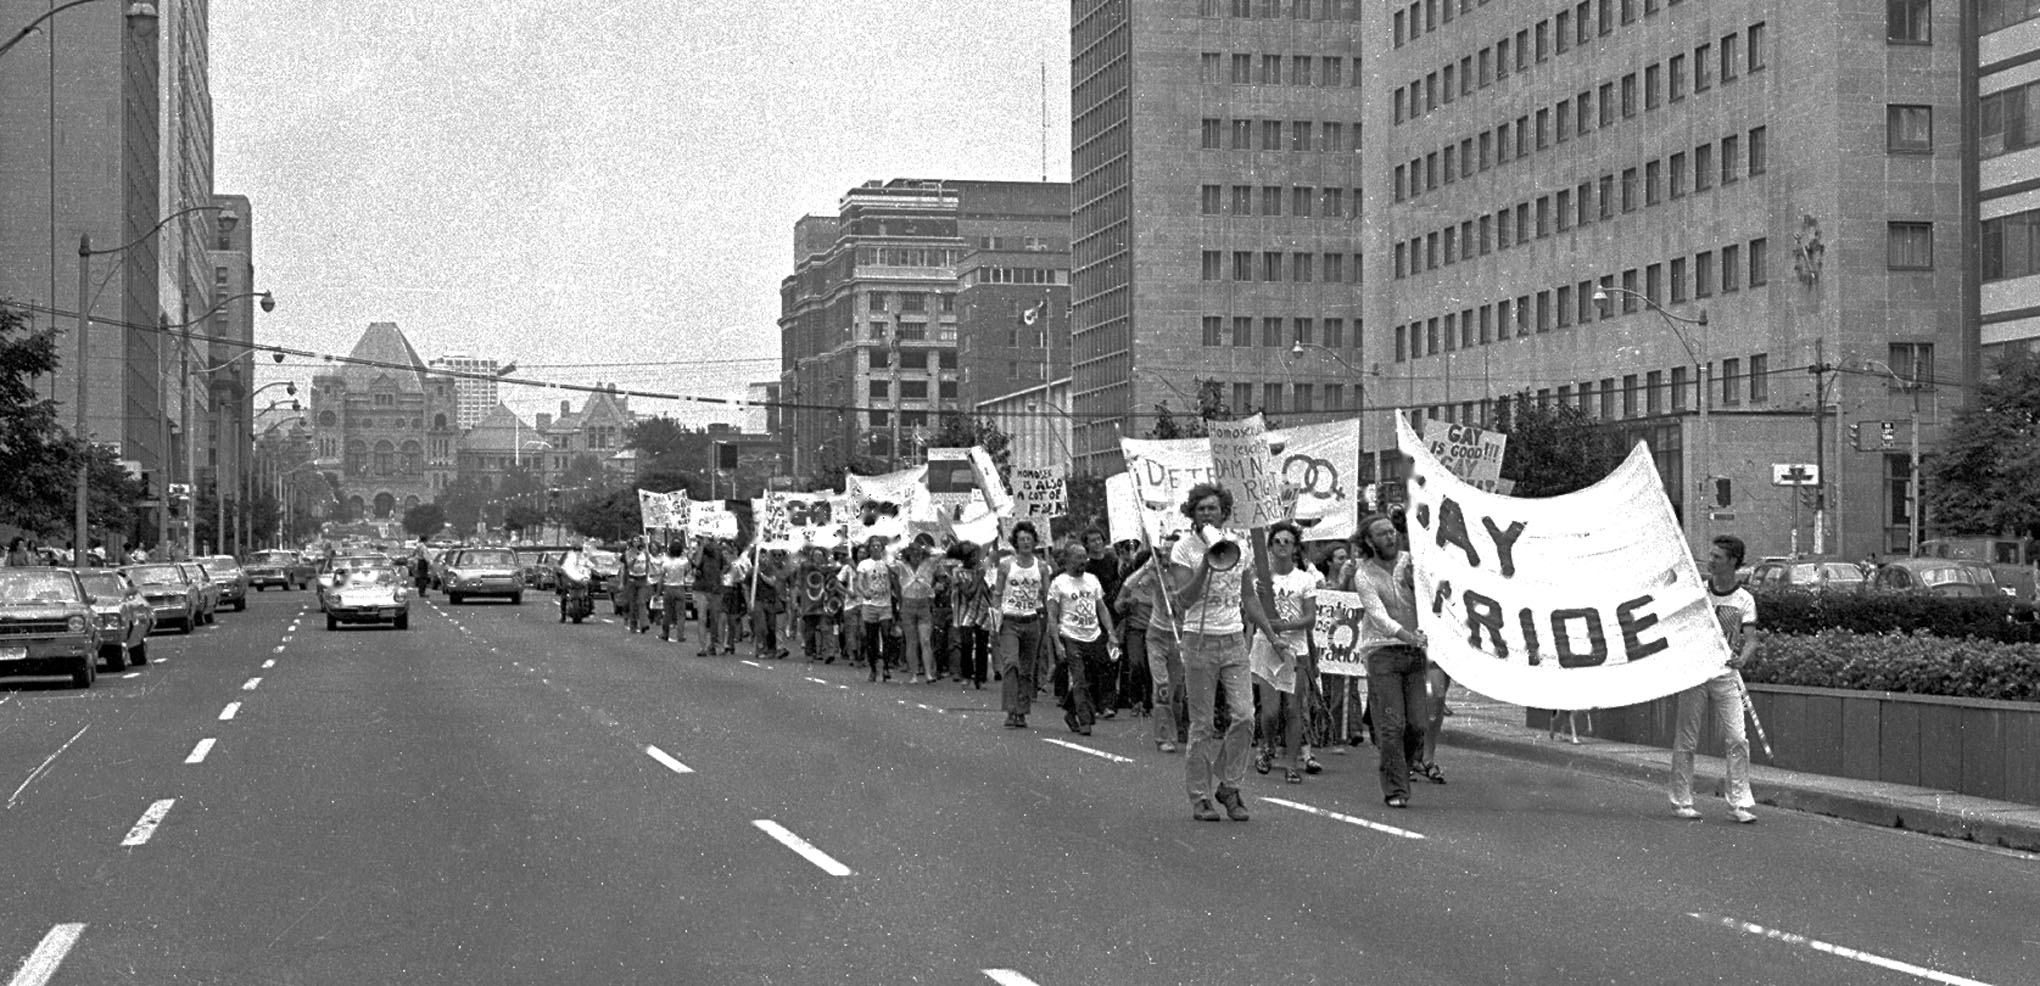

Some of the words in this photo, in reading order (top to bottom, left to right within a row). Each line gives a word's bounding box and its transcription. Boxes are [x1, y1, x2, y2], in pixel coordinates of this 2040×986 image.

[1448, 424, 1483, 446] GAY
[1430, 440, 1446, 455] IS
[1451, 441, 1500, 463] GOOD!!!
[1036, 478, 1063, 491] ALSO
[1017, 490, 1025, 501] A
[1028, 490, 1047, 501] LOT
[1048, 488, 1061, 500] OF
[1415, 496, 1528, 579] AY
[1009, 577, 1038, 587] GAY
[1070, 590, 1091, 601] GAY
[1278, 587, 1295, 599] AY
